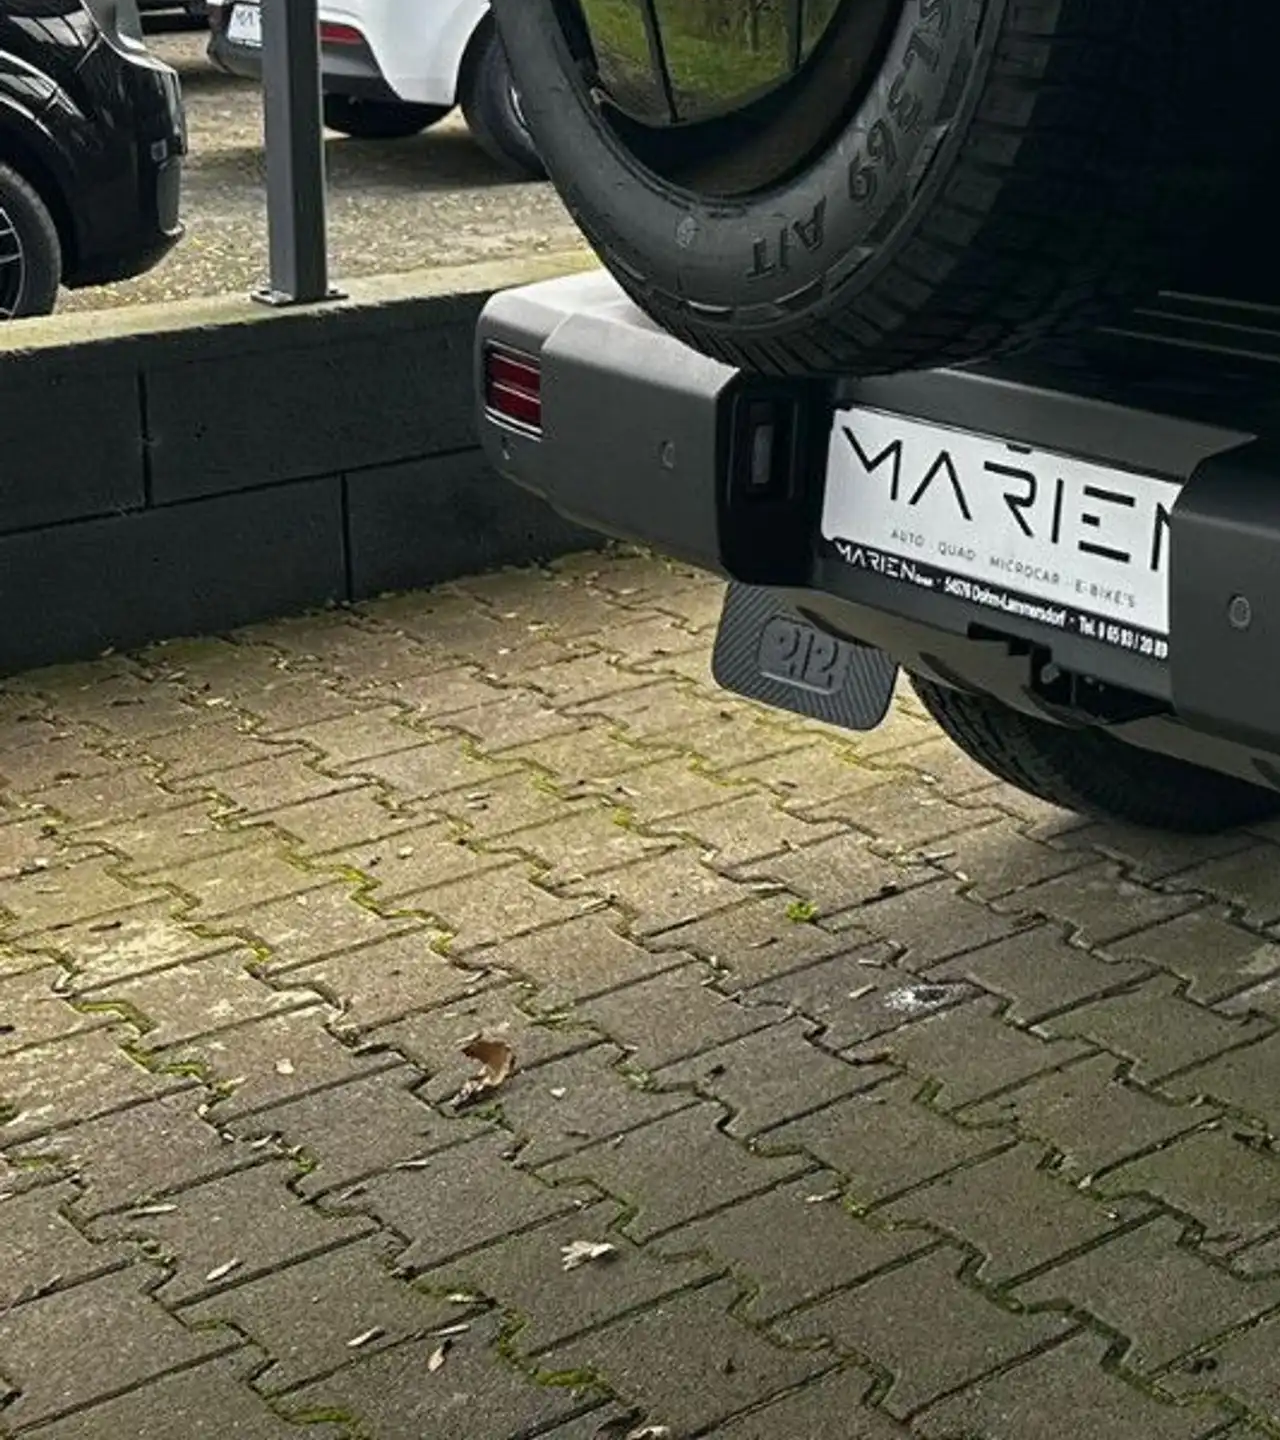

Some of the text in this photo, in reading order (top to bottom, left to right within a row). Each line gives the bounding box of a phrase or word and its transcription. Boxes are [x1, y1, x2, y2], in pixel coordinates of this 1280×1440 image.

[834, 540, 916, 581] MARIEN
[890, 528, 926, 548] AUTO
[937, 541, 976, 562] QUAD
[989, 556, 1061, 585] MICROCAR
